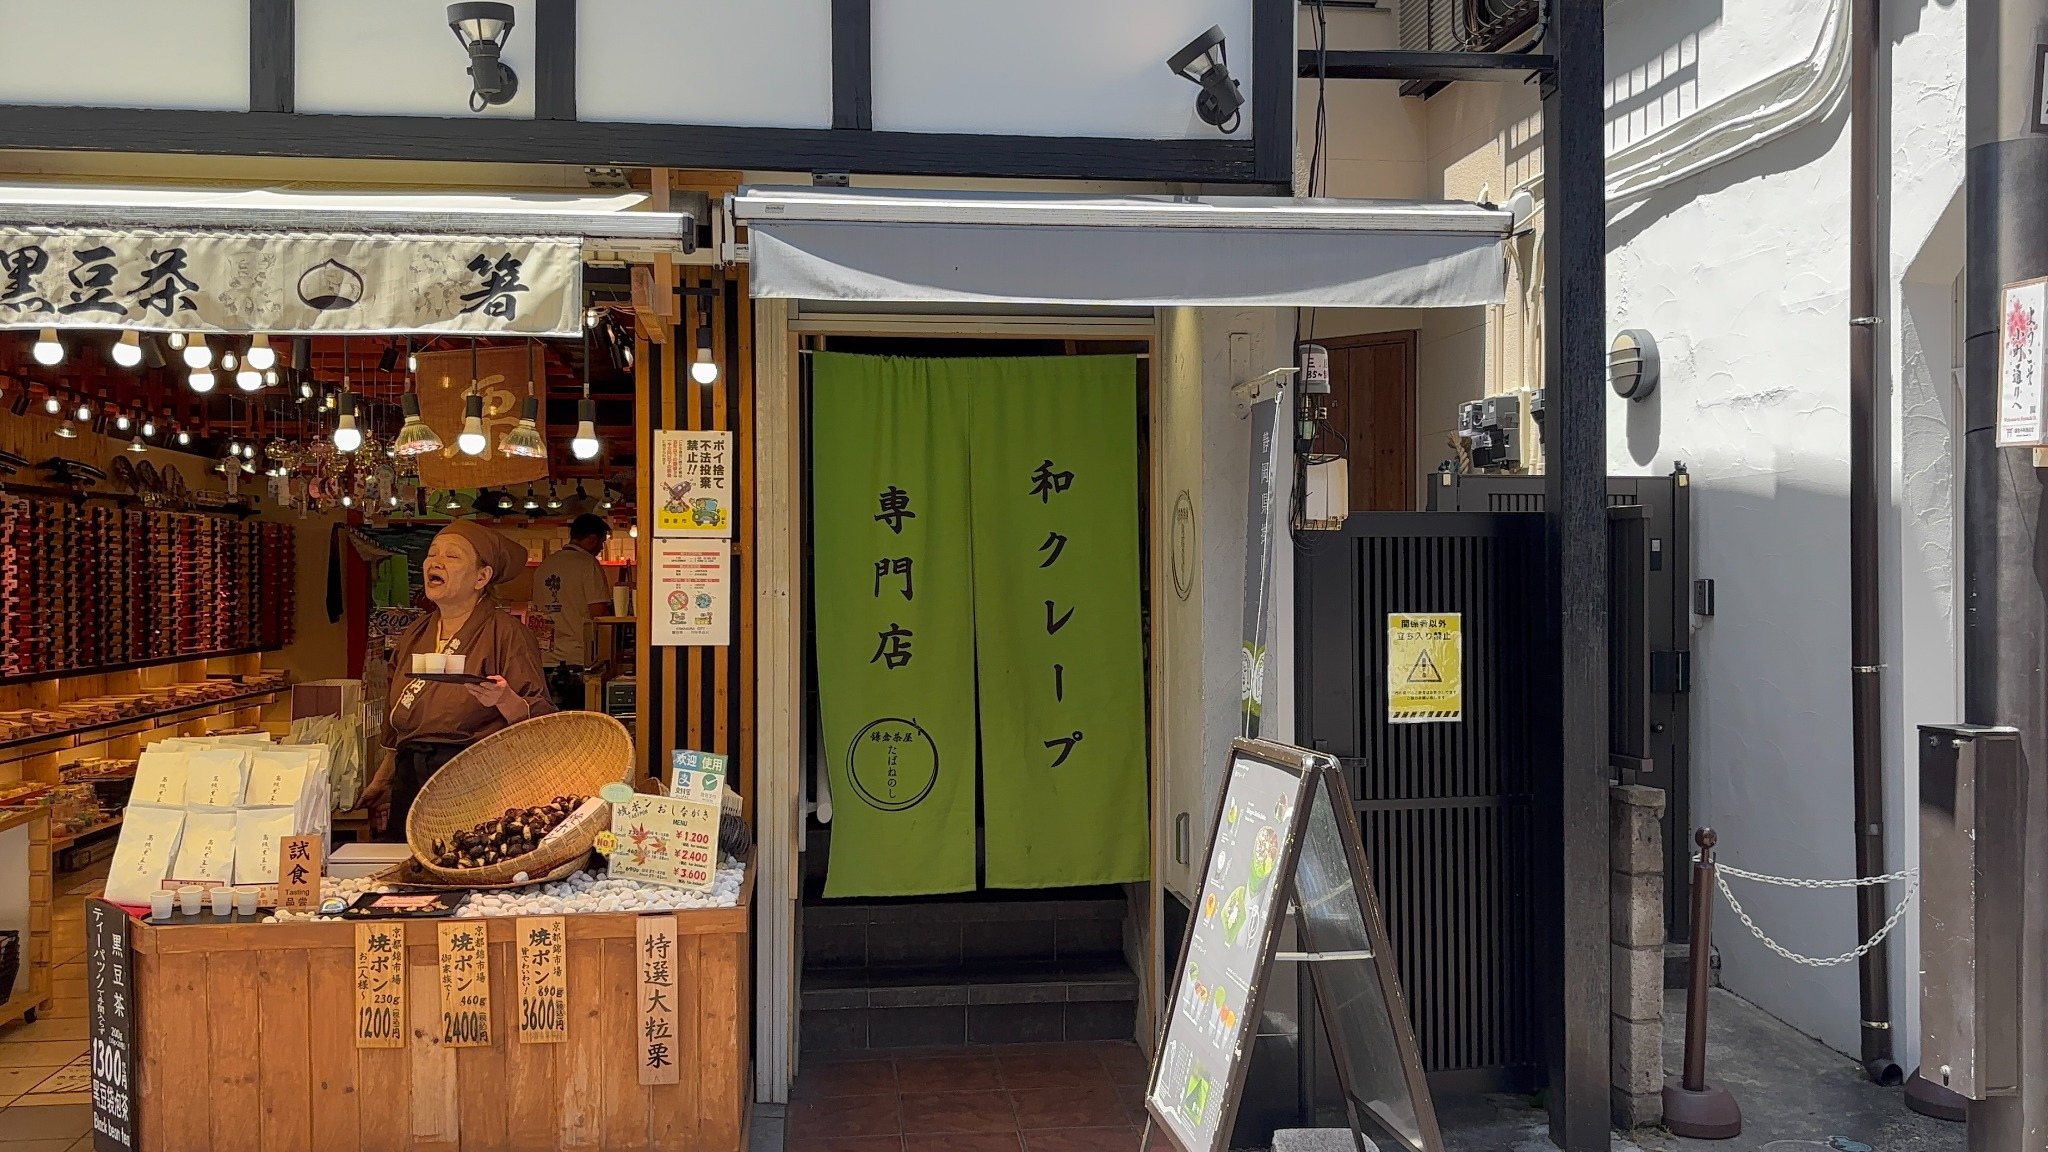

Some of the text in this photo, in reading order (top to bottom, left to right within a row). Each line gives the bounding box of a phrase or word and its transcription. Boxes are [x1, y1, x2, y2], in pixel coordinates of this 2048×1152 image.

[0, 245, 199, 317] 黒豆茶
[460, 252, 529, 321] 箸
[2012, 327, 2024, 410] 小町通りへ
[2026, 306, 2036, 386] ようこそ
[699, 439, 711, 489] 不法投棄
[713, 439, 725, 489] ポイ捨て
[869, 485, 916, 670] 専門店
[1029, 459, 1083, 768] 和クレープ
[1396, 631, 1452, 641] 立ち入り禁止
[1401, 619, 1447, 629] 関係者以外
[676, 752, 723, 772] 欢迎 使用
[870, 731, 913, 743] 鎌倉茶屋
[887, 744, 898, 799] たばねのし
[617, 798, 709, 822] 焼ポン おしながき
[672, 819, 688, 827] MENU
[287, 840, 310, 885] 試食
[285, 888, 310, 897] Tasting
[368, 932, 392, 992] 焼ポン
[391, 927, 402, 986] 京都錦市場
[451, 932, 475, 992] 焼ポン
[474, 925, 486, 983] 京都錦市場
[529, 928, 552, 985] 焼ポン
[552, 920, 562, 977] 京都錦市場
[112, 933, 125, 1018] 黒豆茶
[374, 994, 401, 1006] 230g
[460, 995, 487, 1006] 460g
[538, 985, 564, 998] 690g
[644, 932, 673, 1068] 特選大粒栗
[359, 1006, 391, 1039] 1200
[444, 1011, 478, 1043] 2400
[521, 997, 555, 1031] 3600
[93, 1037, 121, 1087] 1300
[93, 1079, 129, 1121] 黒豆袋泡茶
[94, 1111, 131, 1147] Black bean tea
